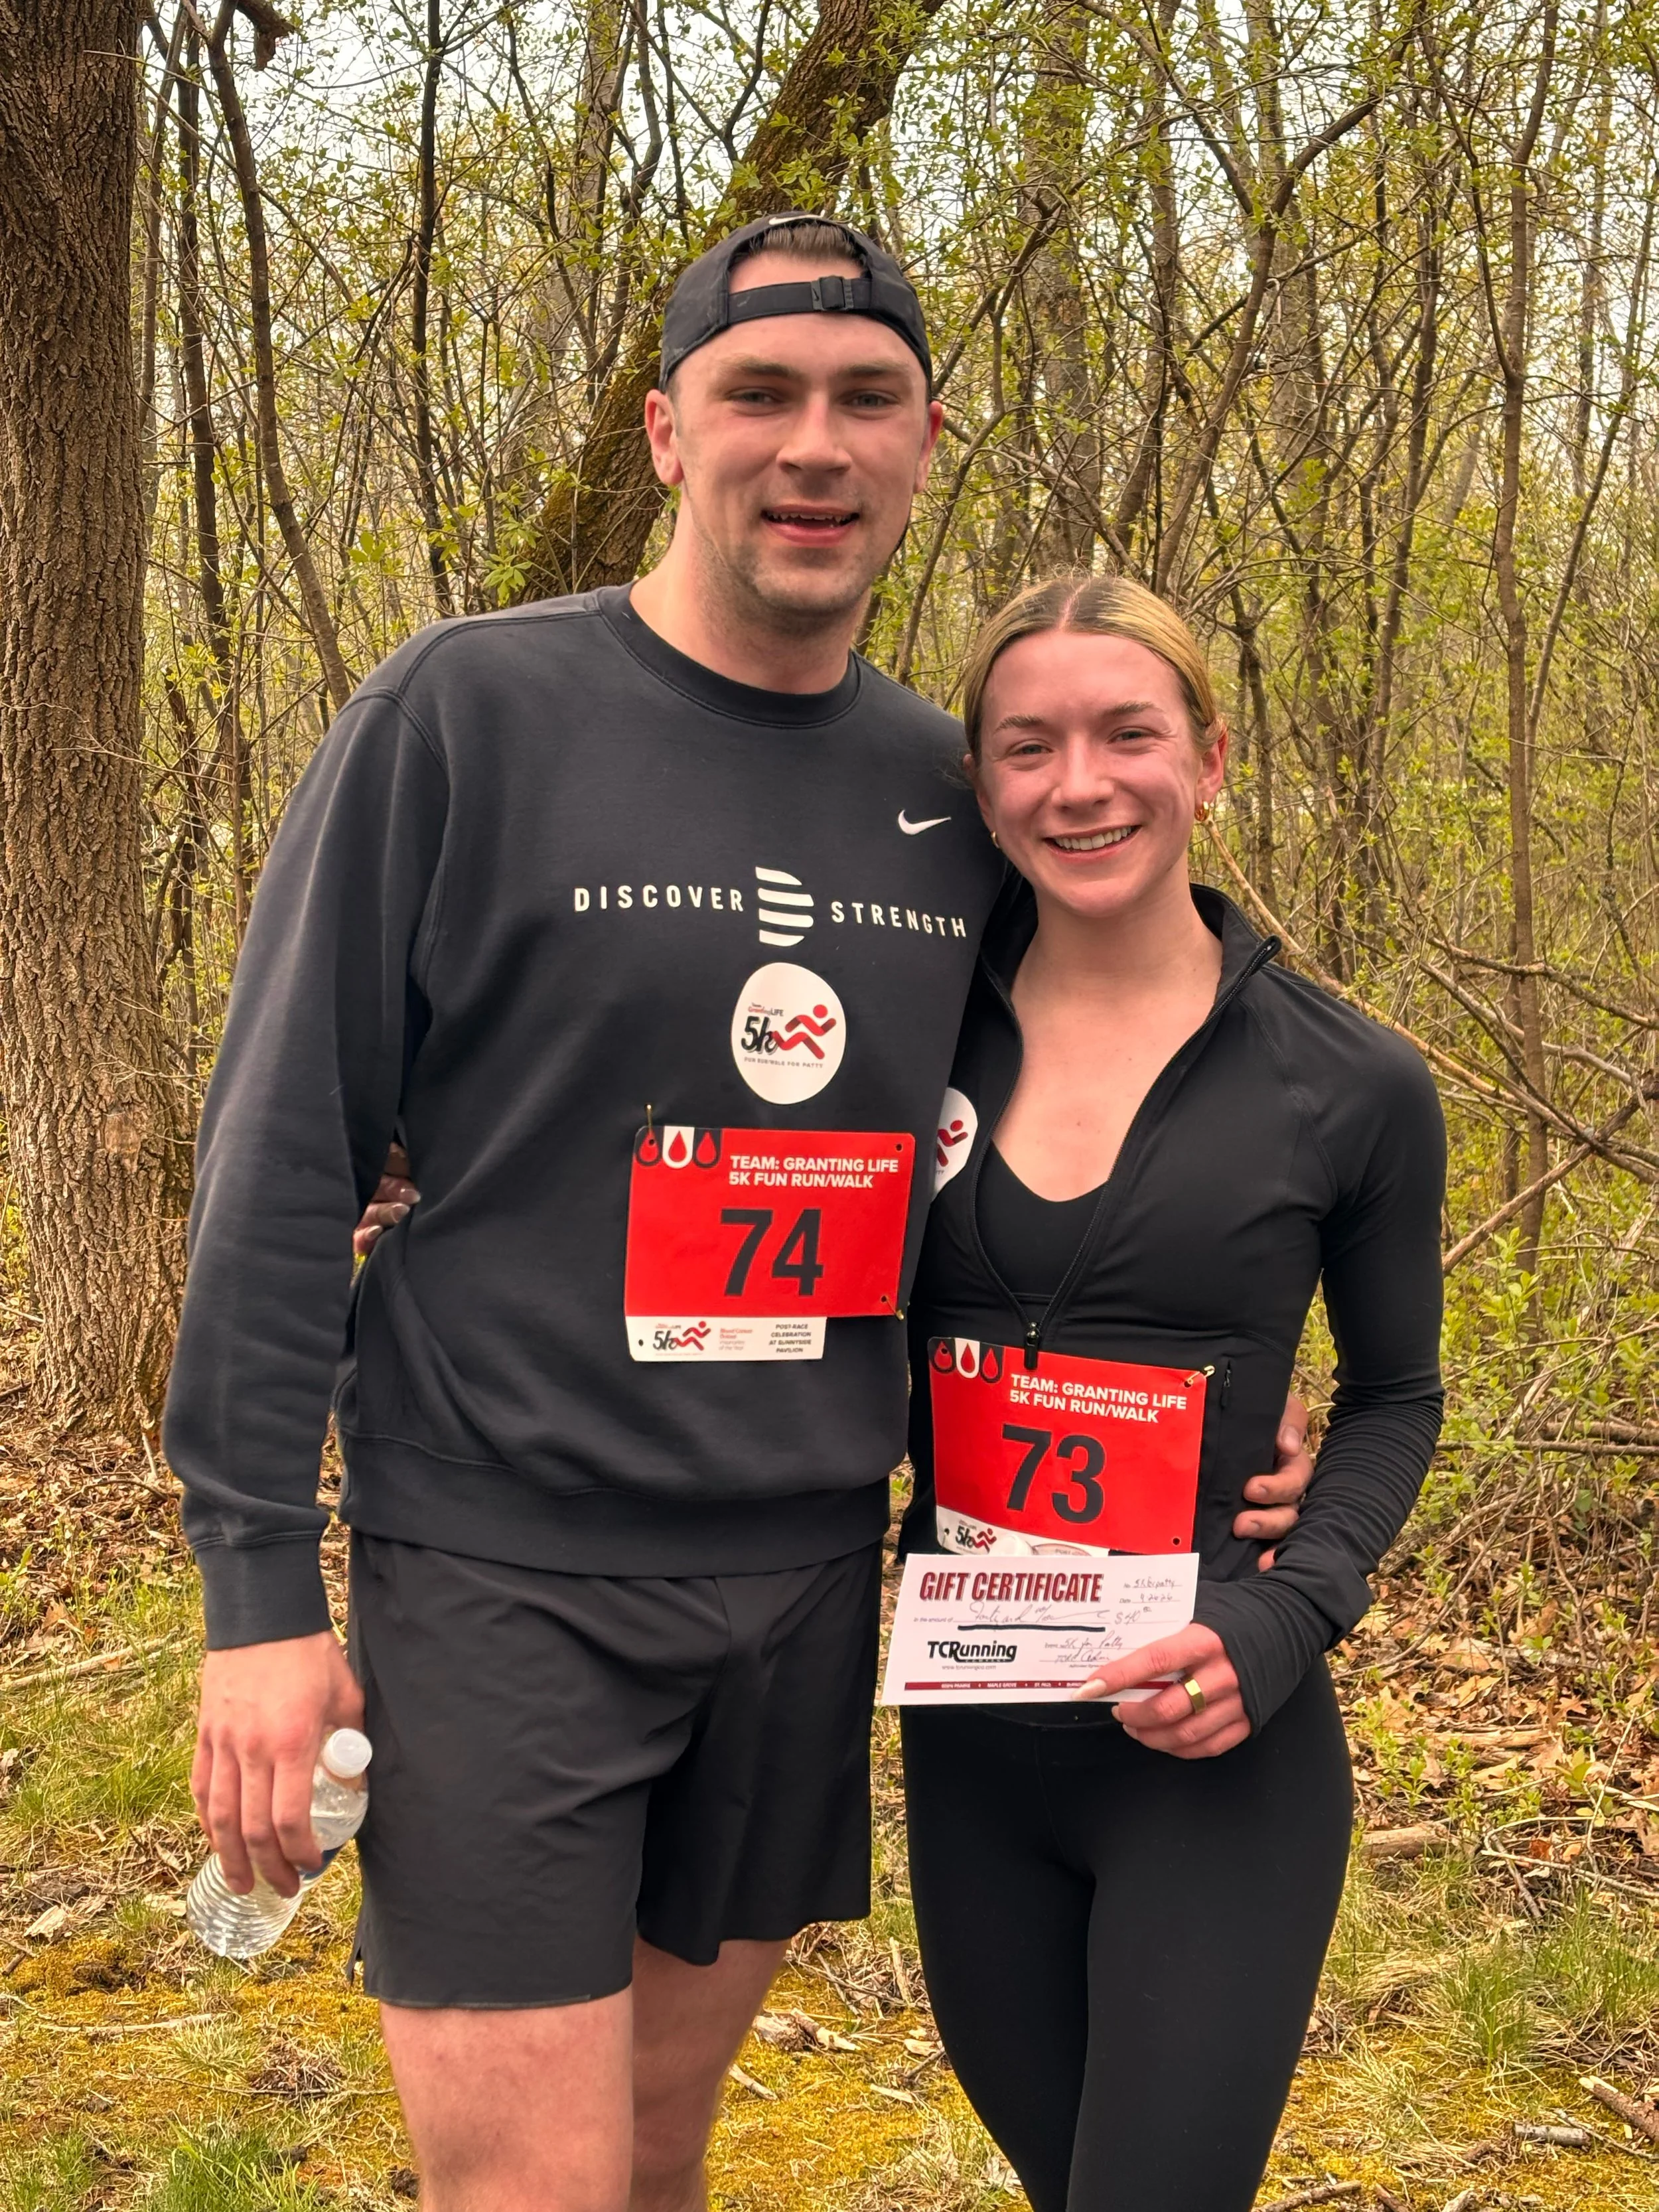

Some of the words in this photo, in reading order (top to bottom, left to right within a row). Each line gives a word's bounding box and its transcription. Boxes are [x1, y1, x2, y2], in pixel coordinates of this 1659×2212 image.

[574, 885, 745, 913] DISCOVER
[831, 901, 968, 938] STRENGTH
[729, 1172, 751, 1186] 5K
[754, 1173, 788, 1187] FUN
[791, 1173, 874, 1189] RUN/WALK
[730, 1155, 780, 1171] TEAM:
[783, 1157, 864, 1173] GRANTING
[868, 1159, 899, 1173] LIFE
[720, 1208, 824, 1297] 74
[1009, 1390, 1030, 1405] 5K
[1033, 1392, 1066, 1411] FUN
[1070, 1397, 1159, 1423] RUN/WALK
[1011, 1373, 1058, 1393] TEAM:
[1062, 1382, 1149, 1406] GRANTING
[1152, 1394, 1187, 1410] LIFE
[1001, 1423, 1107, 1524] 73
[919, 1572, 971, 1601] GIFT
[971, 1572, 1104, 1603] CERTIFICATE
[927, 1640, 1018, 1662] TCRunning
